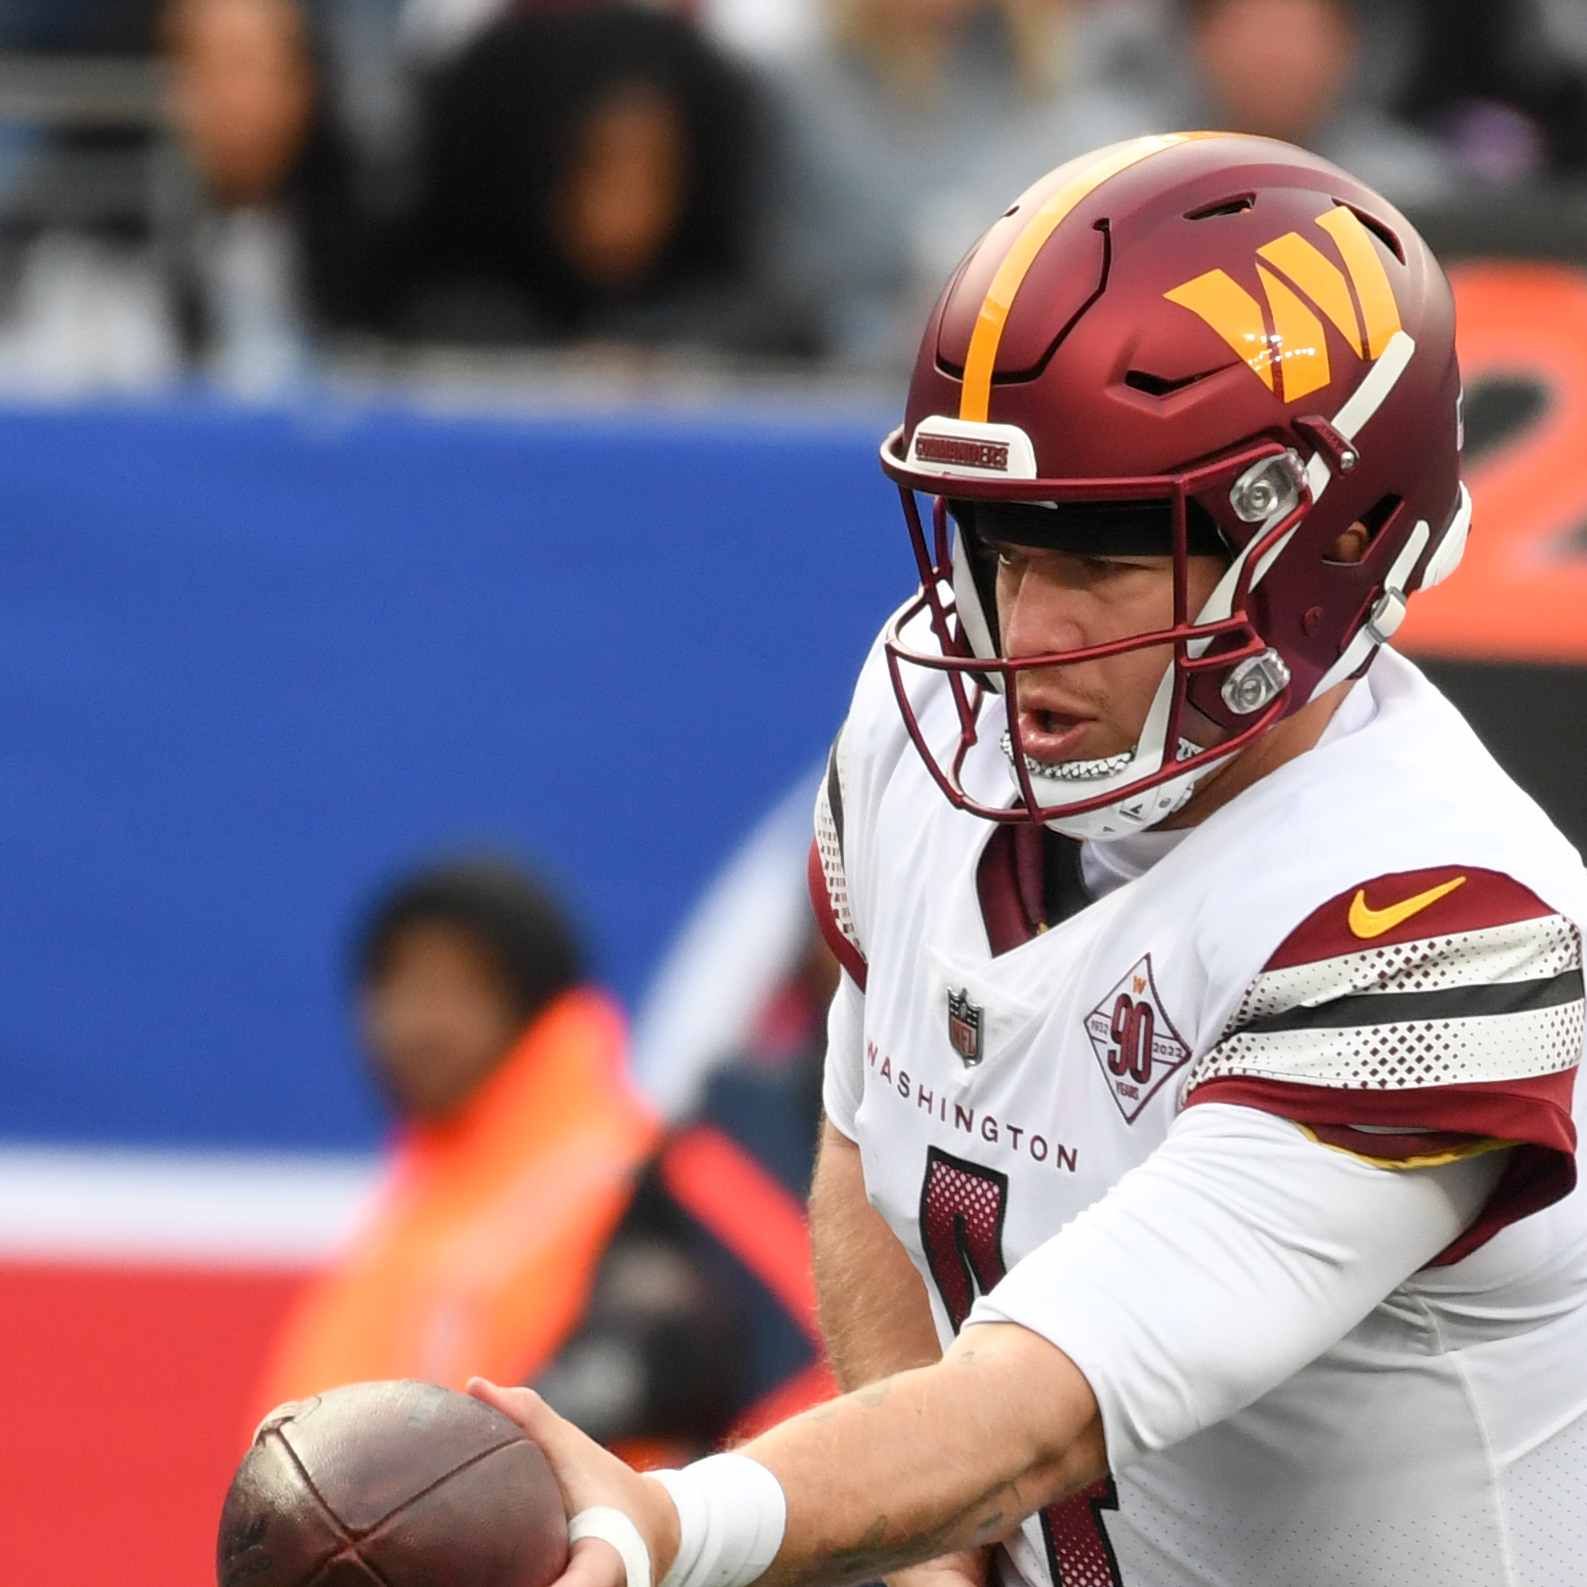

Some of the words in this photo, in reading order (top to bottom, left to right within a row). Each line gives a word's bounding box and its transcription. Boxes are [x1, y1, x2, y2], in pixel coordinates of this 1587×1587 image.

[1107, 992, 1155, 1085] 90
[1152, 1041, 1183, 1059] 2022
[866, 1041, 1079, 1173] WASHINGTON
[1115, 1079, 1140, 1101] YEARS
